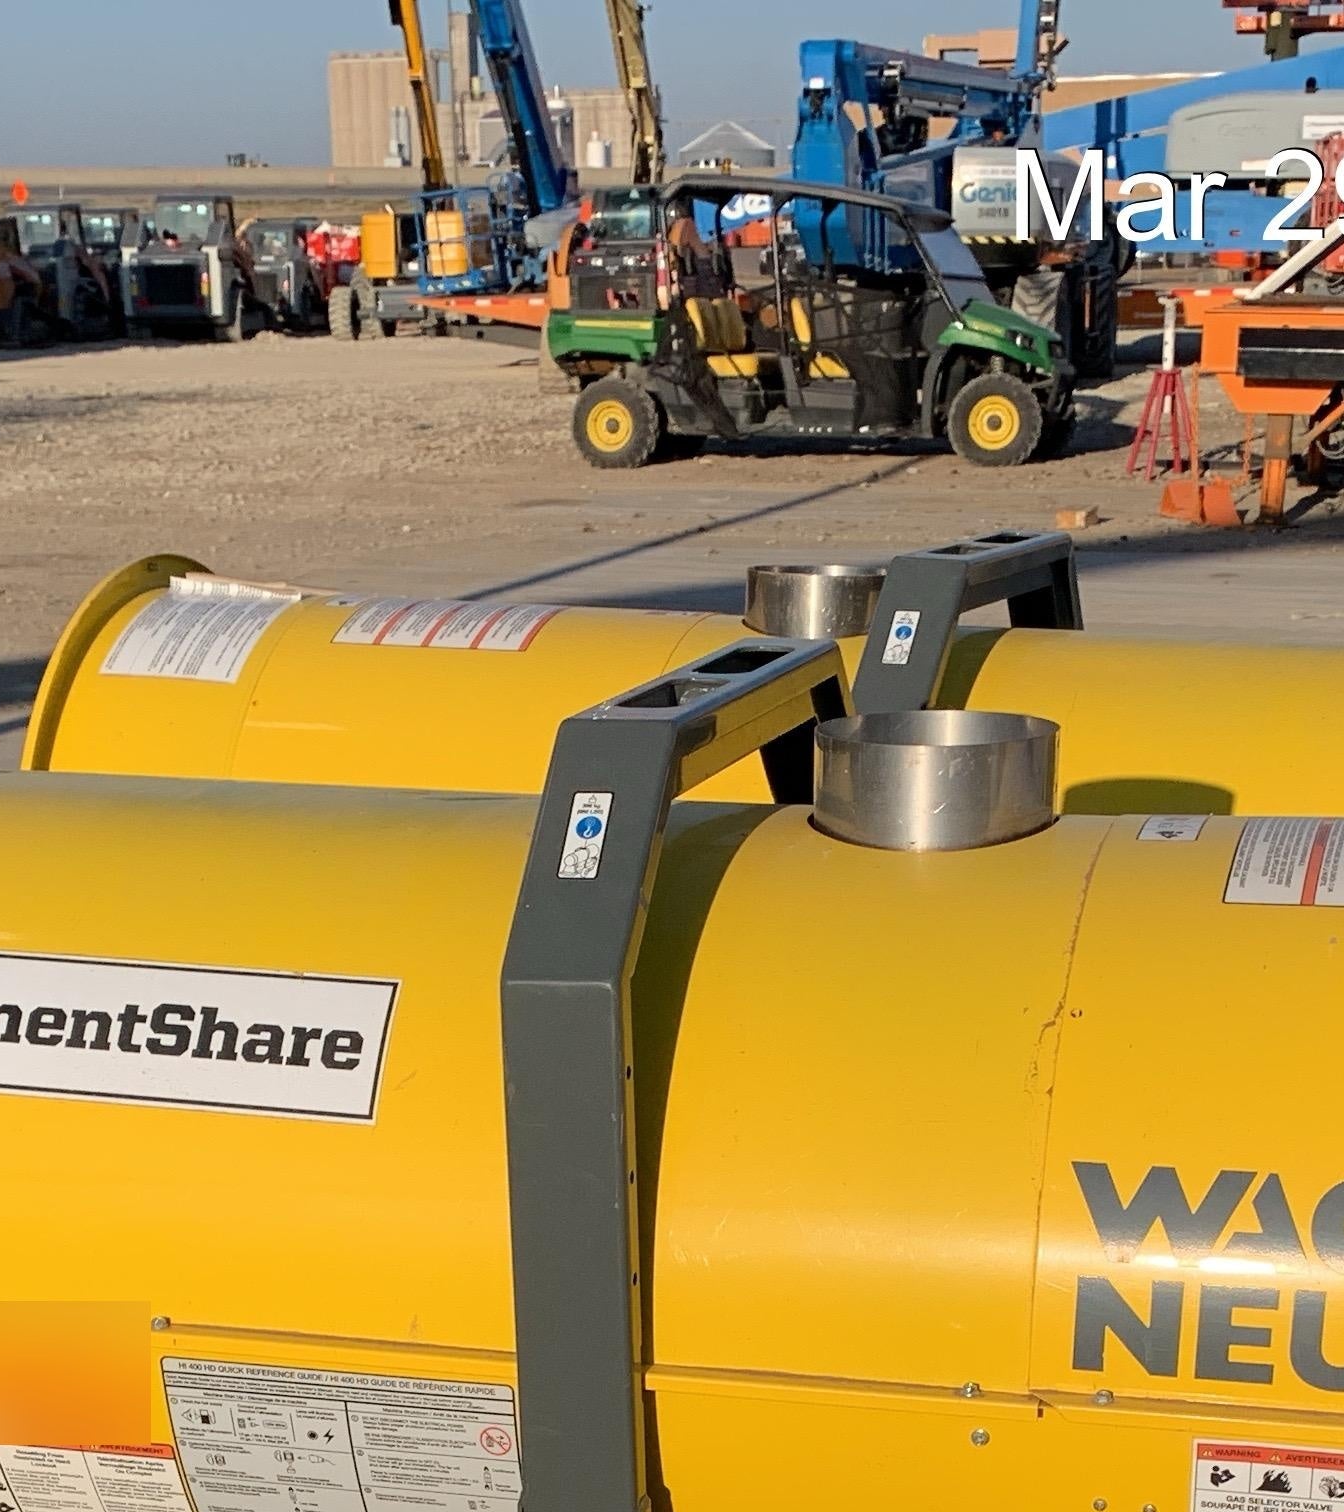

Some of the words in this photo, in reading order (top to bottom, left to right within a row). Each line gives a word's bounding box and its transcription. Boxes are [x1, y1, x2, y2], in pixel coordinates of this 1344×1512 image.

[960, 181, 1017, 203] Geni
[1215, 1447, 1260, 1458] WARNING
[1200, 1500, 1244, 1511] SOUPAPE
[1247, 1504, 1260, 1512] DE
[1226, 1494, 1245, 1503] GAS
[1248, 1496, 1300, 1508] SELECTOR
[1303, 1501, 1333, 1512] VALVE
